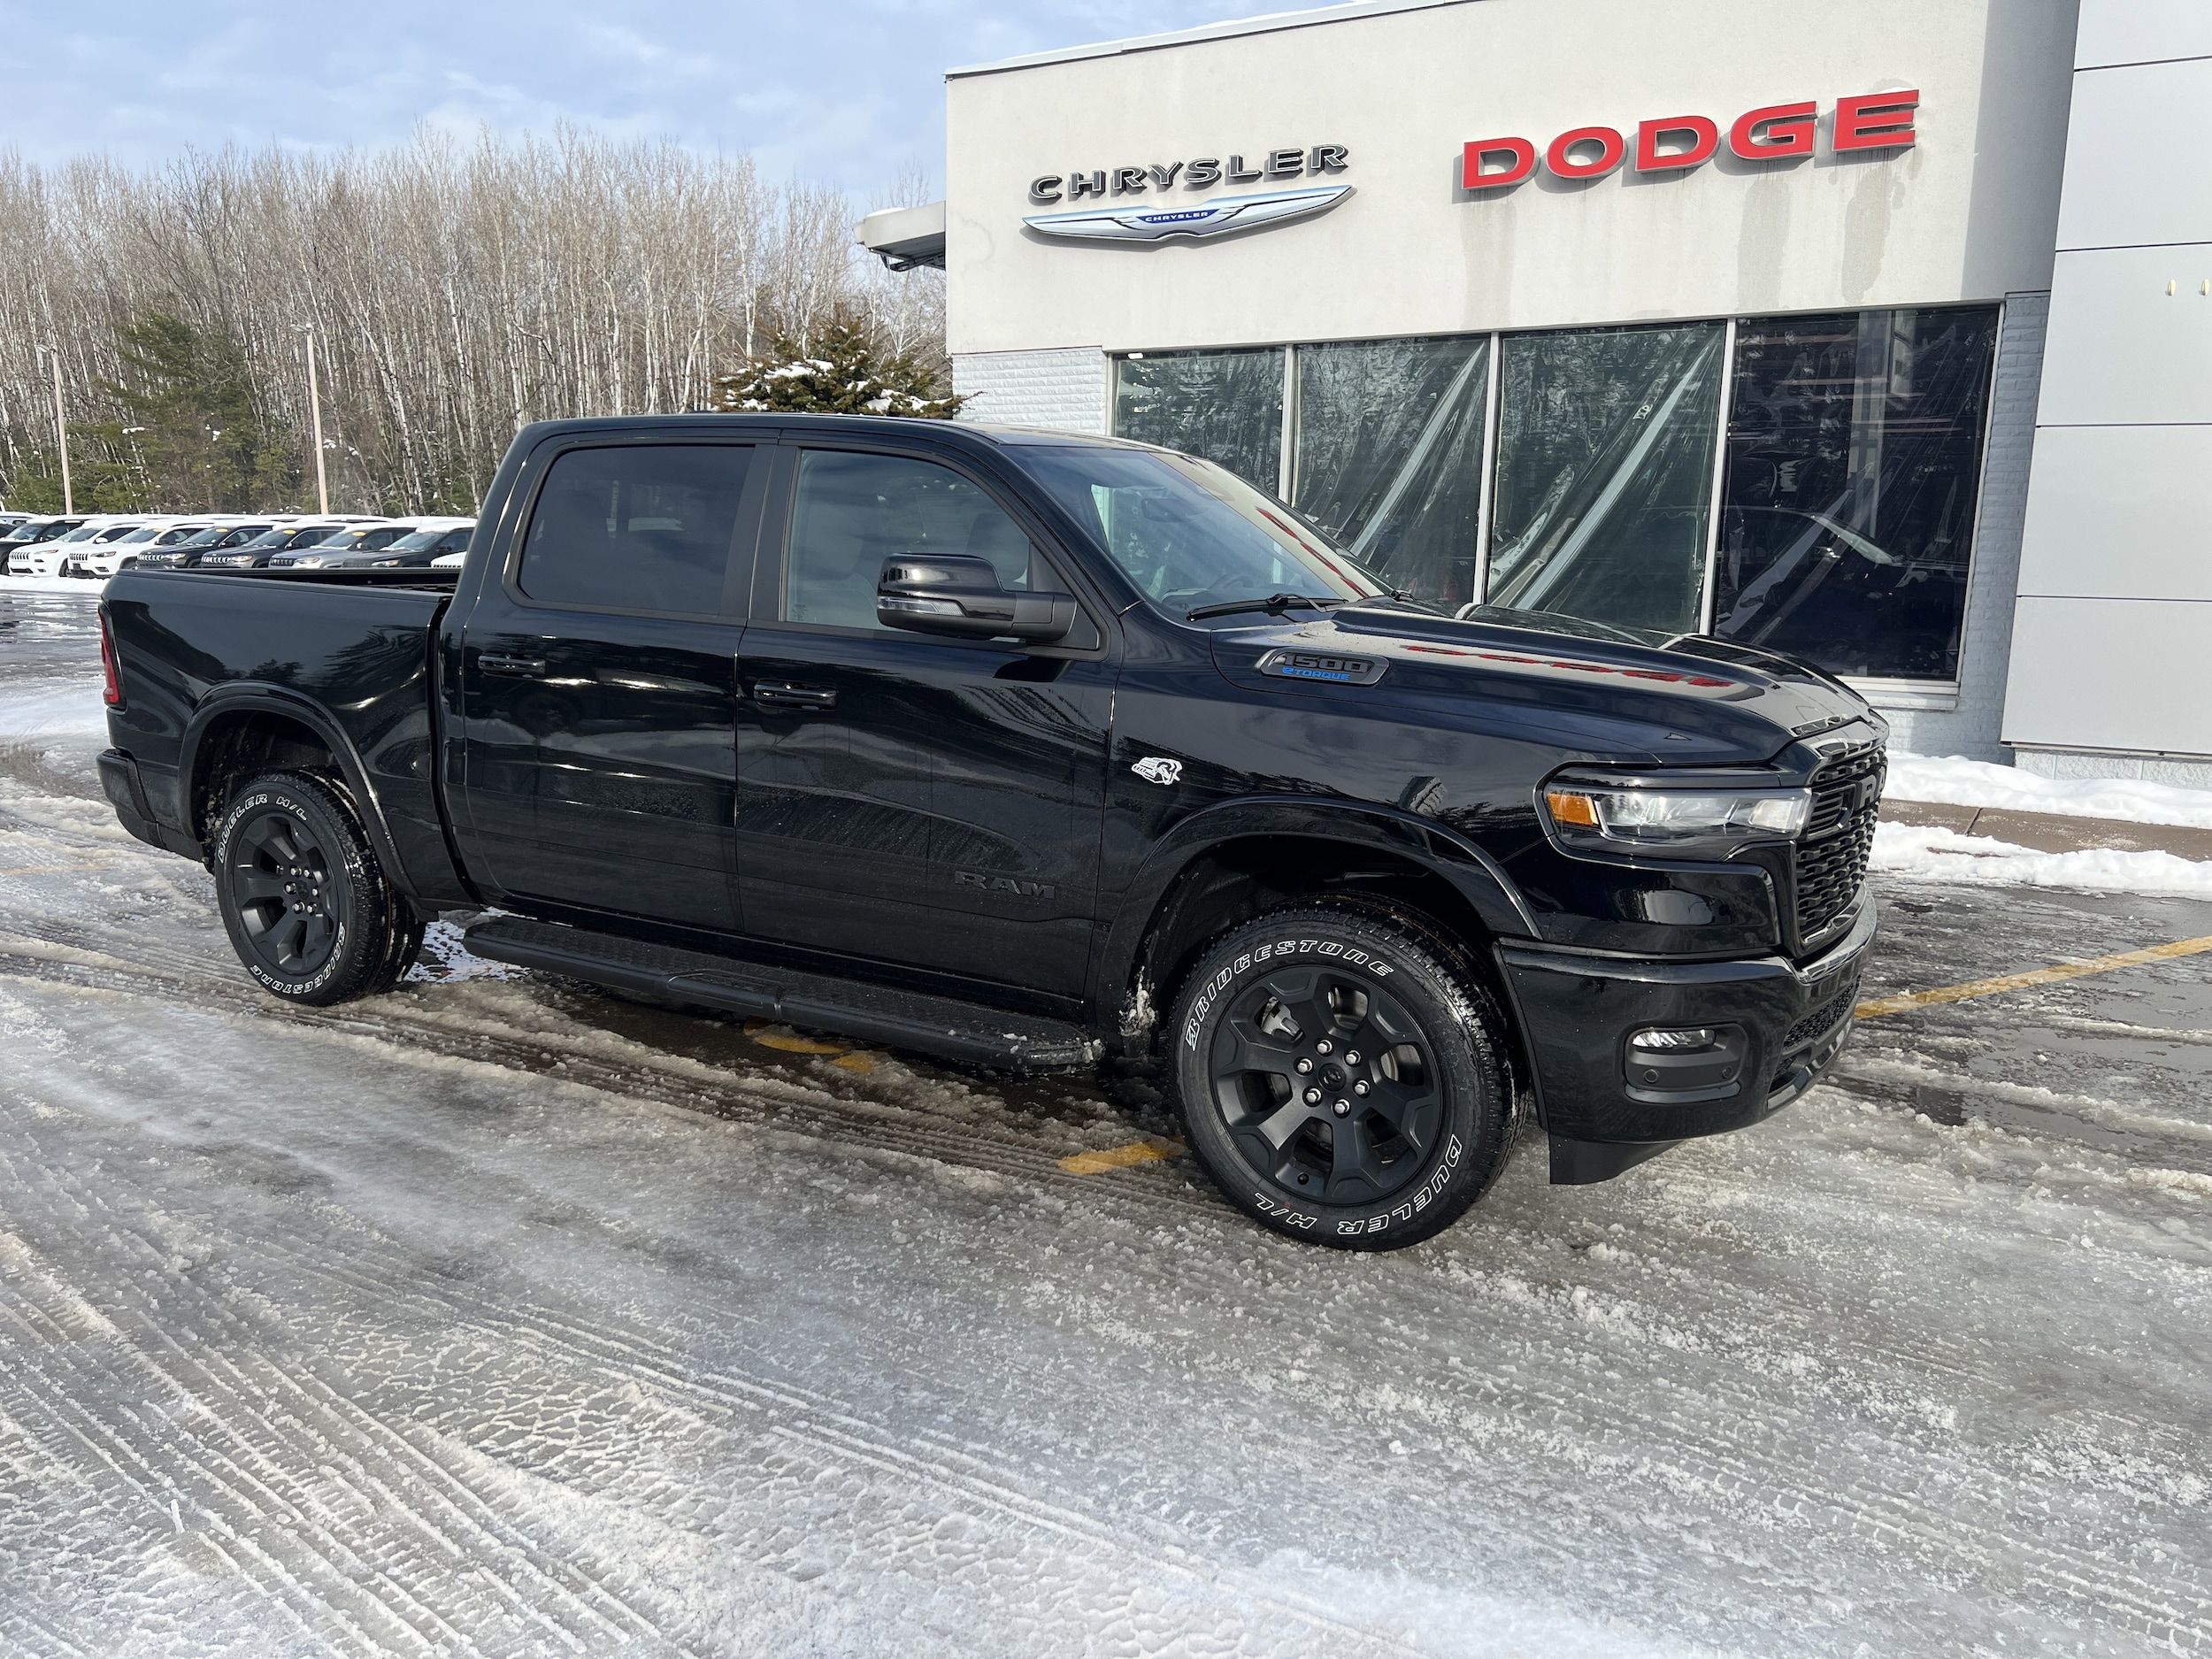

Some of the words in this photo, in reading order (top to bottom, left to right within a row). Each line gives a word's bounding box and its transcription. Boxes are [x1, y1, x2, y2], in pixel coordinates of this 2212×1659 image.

[1463, 89, 1918, 189] DODGE
[1029, 143, 1348, 199] CHRYSLER
[1145, 211, 1210, 222] CHRYSLER
[1275, 654, 1371, 672] 1500
[218, 794, 268, 864] DUELER
[275, 796, 307, 821] H/L
[955, 871, 1055, 899] RAM
[250, 922, 346, 994] BRIDGESTONE
[1184, 939, 1394, 1052] BRIDGESTONE
[1254, 1192, 1318, 1231] H/L
[1337, 1133, 1463, 1235] DUELER
